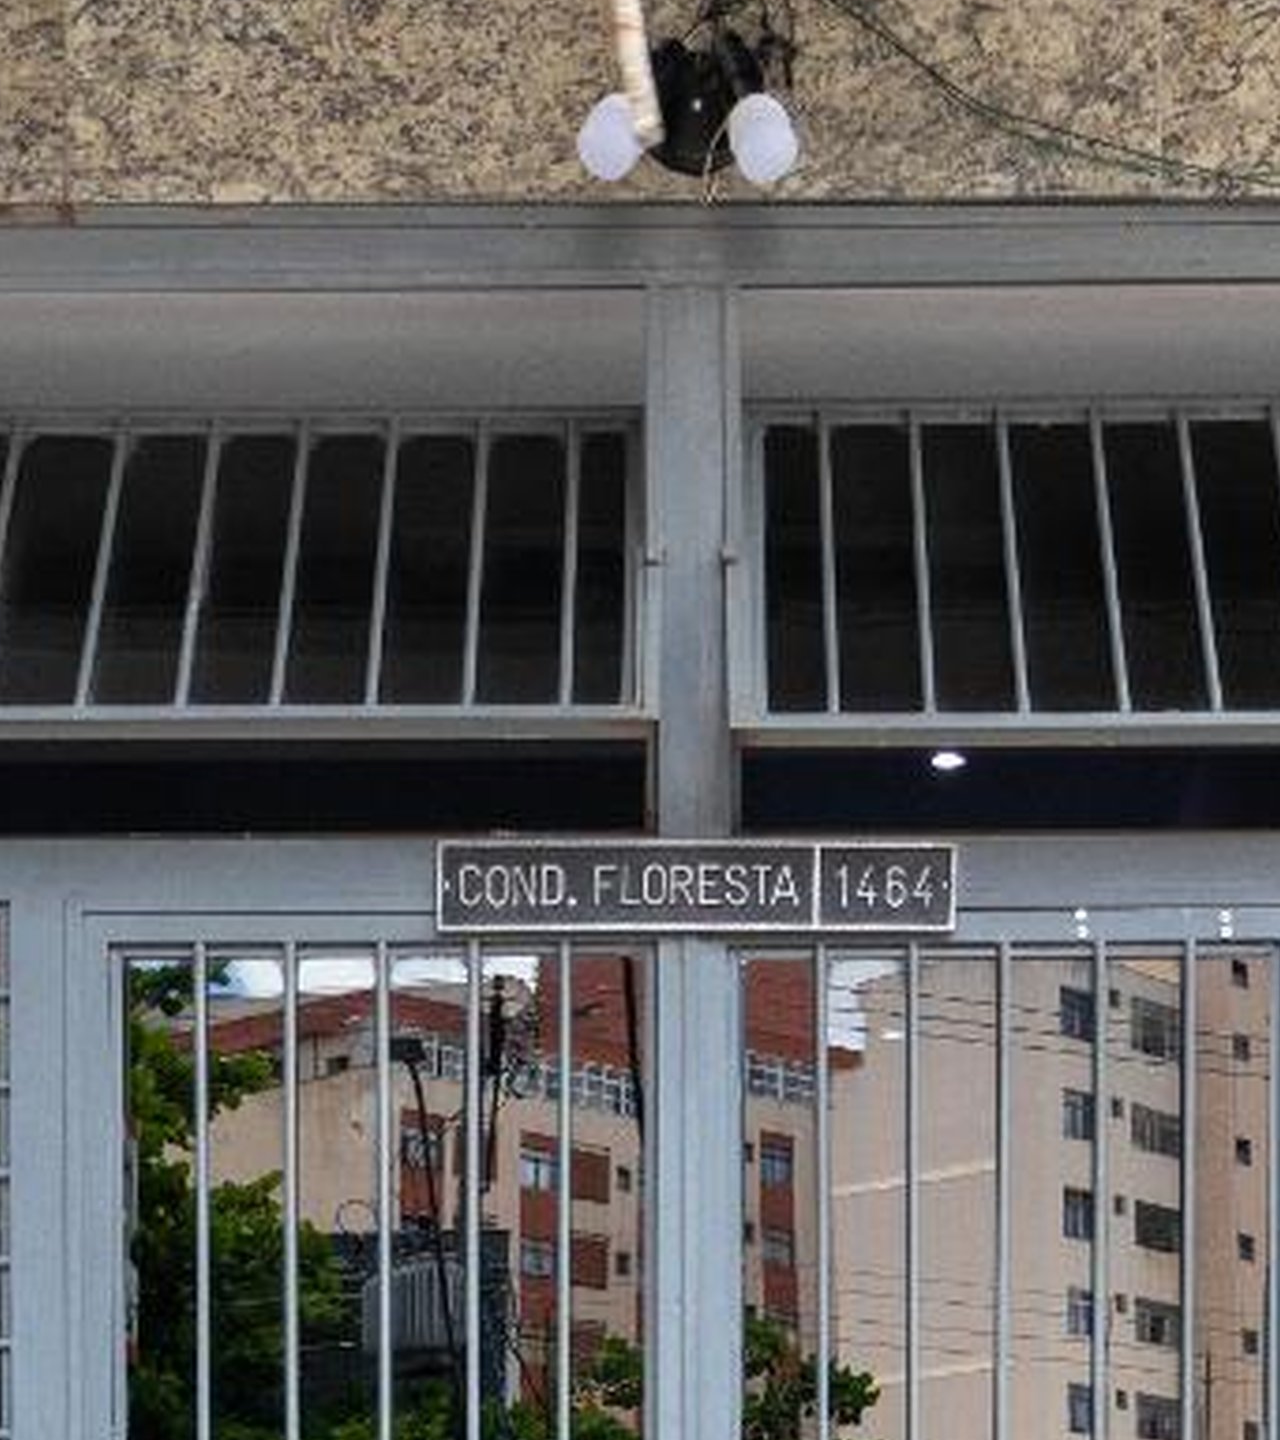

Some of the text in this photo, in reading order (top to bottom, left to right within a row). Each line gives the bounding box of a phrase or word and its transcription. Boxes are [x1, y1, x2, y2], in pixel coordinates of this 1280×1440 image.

[457, 863, 933, 909] COND. FLORESTA 1464
